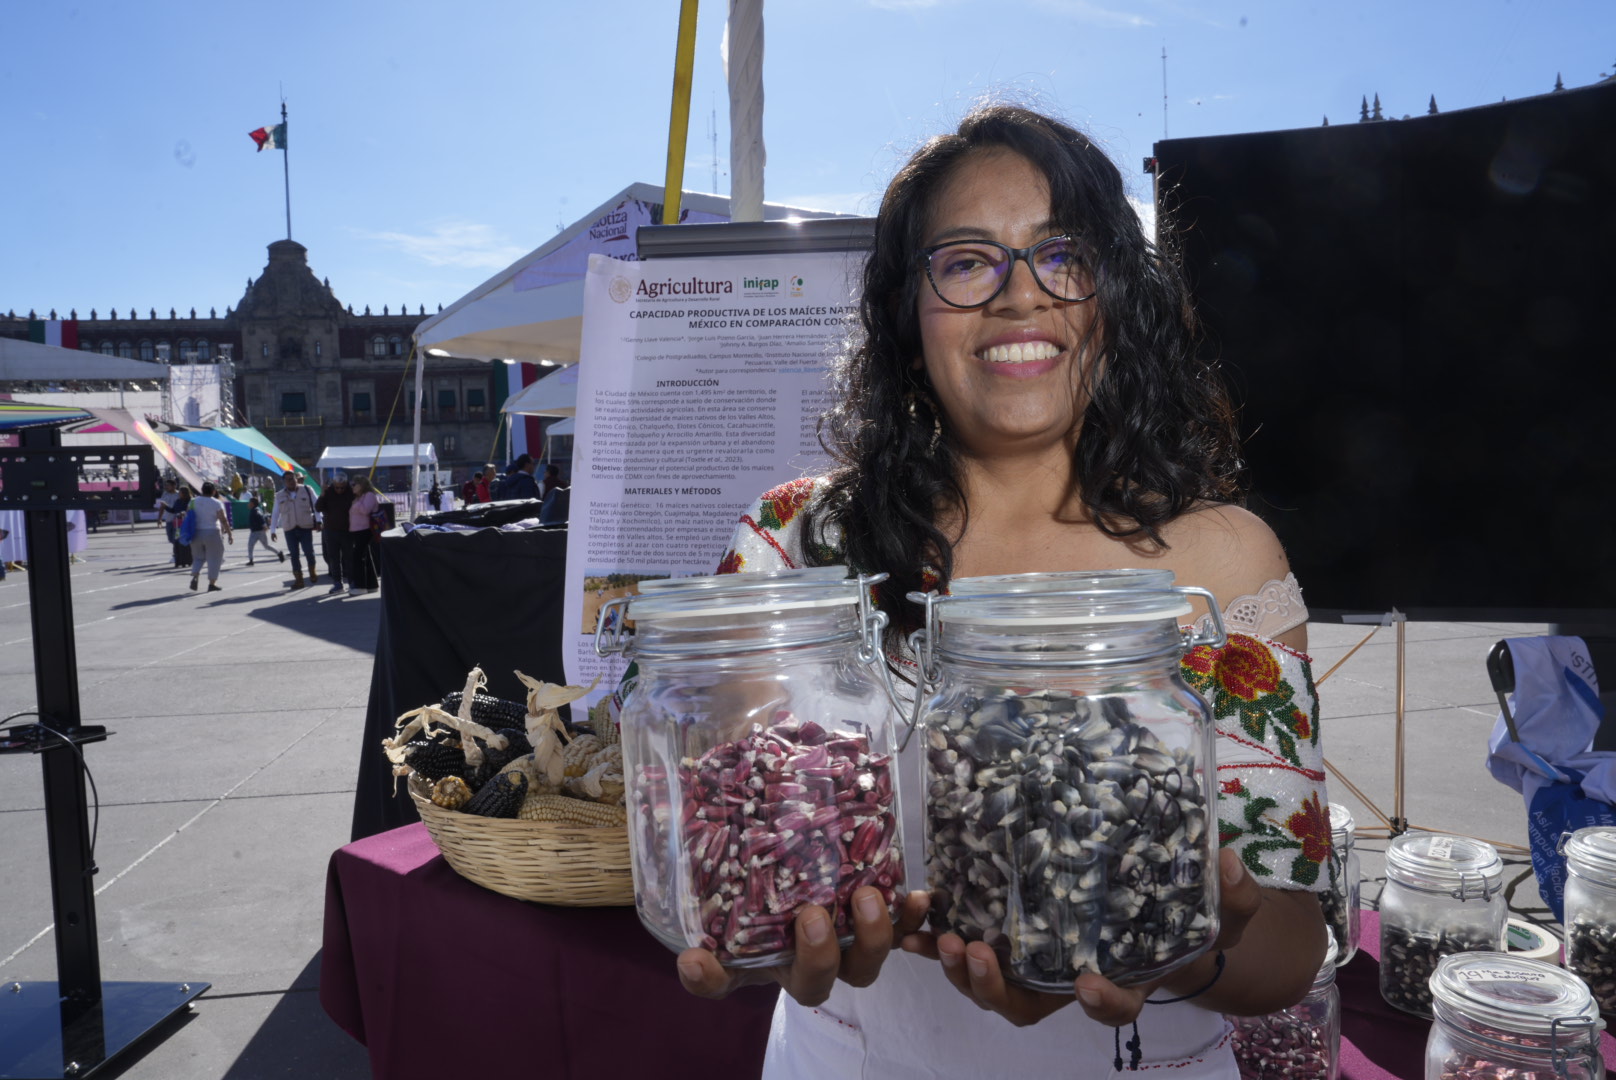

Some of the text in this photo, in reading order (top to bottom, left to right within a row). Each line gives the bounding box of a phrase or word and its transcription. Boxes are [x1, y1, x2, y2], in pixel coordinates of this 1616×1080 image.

[591, 212, 627, 228] otiza
[590, 223, 627, 240] Nacional
[636, 278, 732, 298] Agricultura
[744, 277, 779, 290] inifap
[630, 310, 685, 319] CAPACIDAD
[688, 309, 750, 317] PRODUCTIVA
[790, 305, 826, 315] MAÍCES
[830, 306, 860, 314] NATIV
[689, 319, 727, 329] MÉXICO
[745, 317, 820, 327] COMPARACIÓN
[656, 376, 719, 387] INTRODUCCIÓN
[682, 486, 721, 495] MÉTODOS
[1533, 811, 1552, 832] Así,
[1529, 822, 1556, 858] ampus
[1552, 861, 1565, 903] lación.
